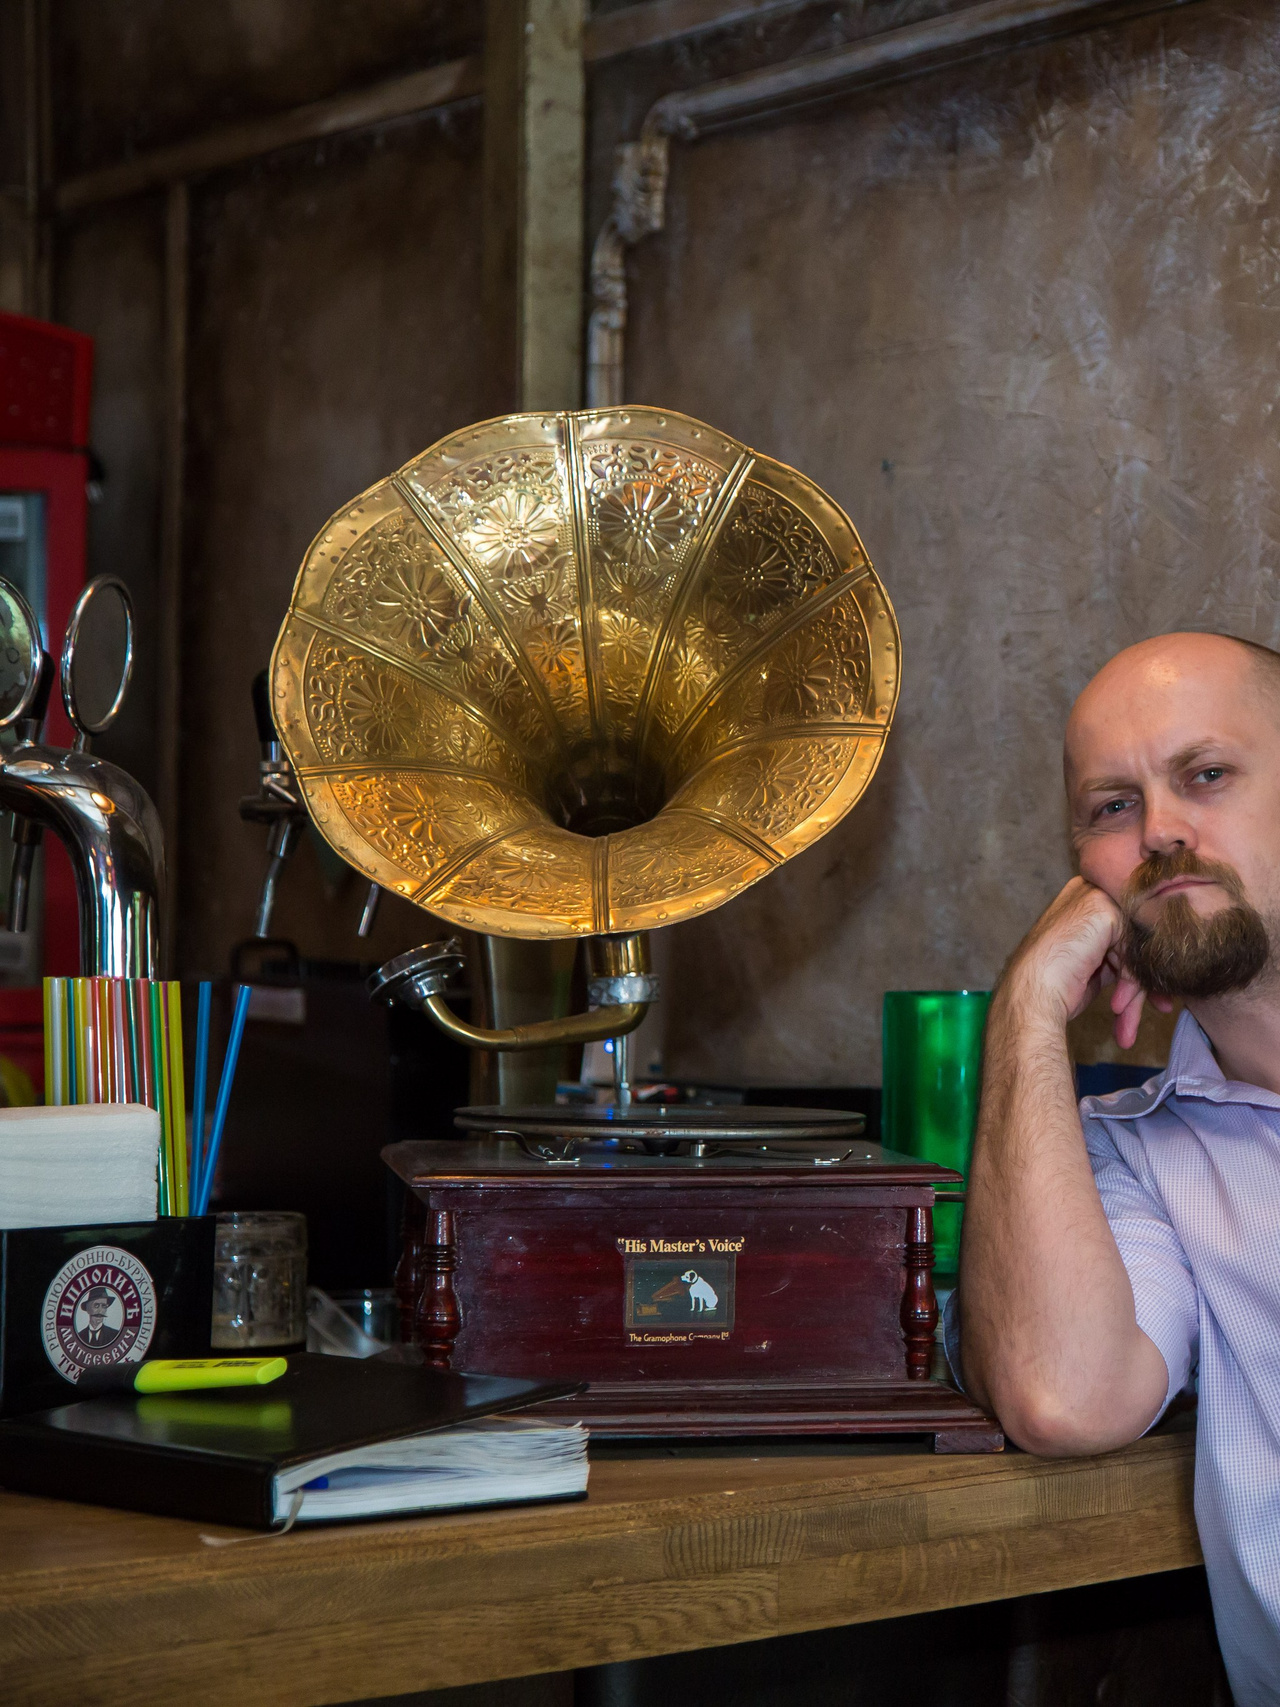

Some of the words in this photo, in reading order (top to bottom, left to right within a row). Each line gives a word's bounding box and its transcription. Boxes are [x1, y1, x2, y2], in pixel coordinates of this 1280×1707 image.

[649, 1239, 706, 1253] Master's
[629, 1333, 642, 1342] The
[643, 1333, 687, 1343] Gramophone
